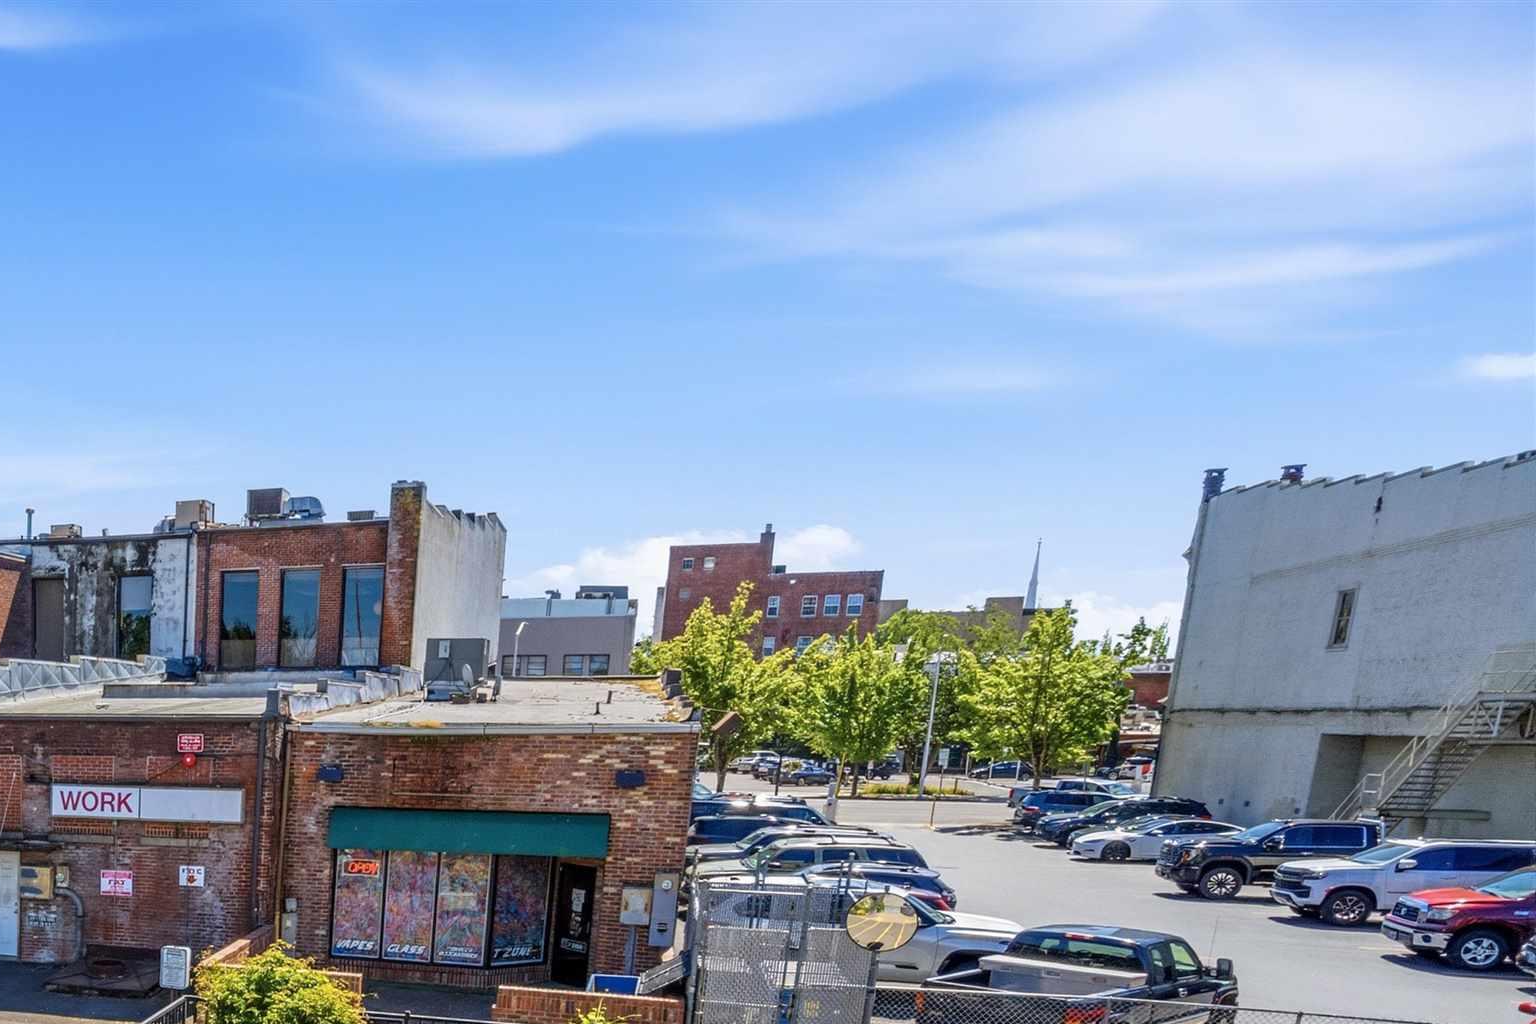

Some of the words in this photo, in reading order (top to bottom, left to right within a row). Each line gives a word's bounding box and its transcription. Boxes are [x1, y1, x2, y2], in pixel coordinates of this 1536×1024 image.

[59, 790, 133, 813] WORK
[348, 862, 377, 874] OPEN
[336, 938, 376, 951] VAPES
[387, 943, 426, 954] GLASS
